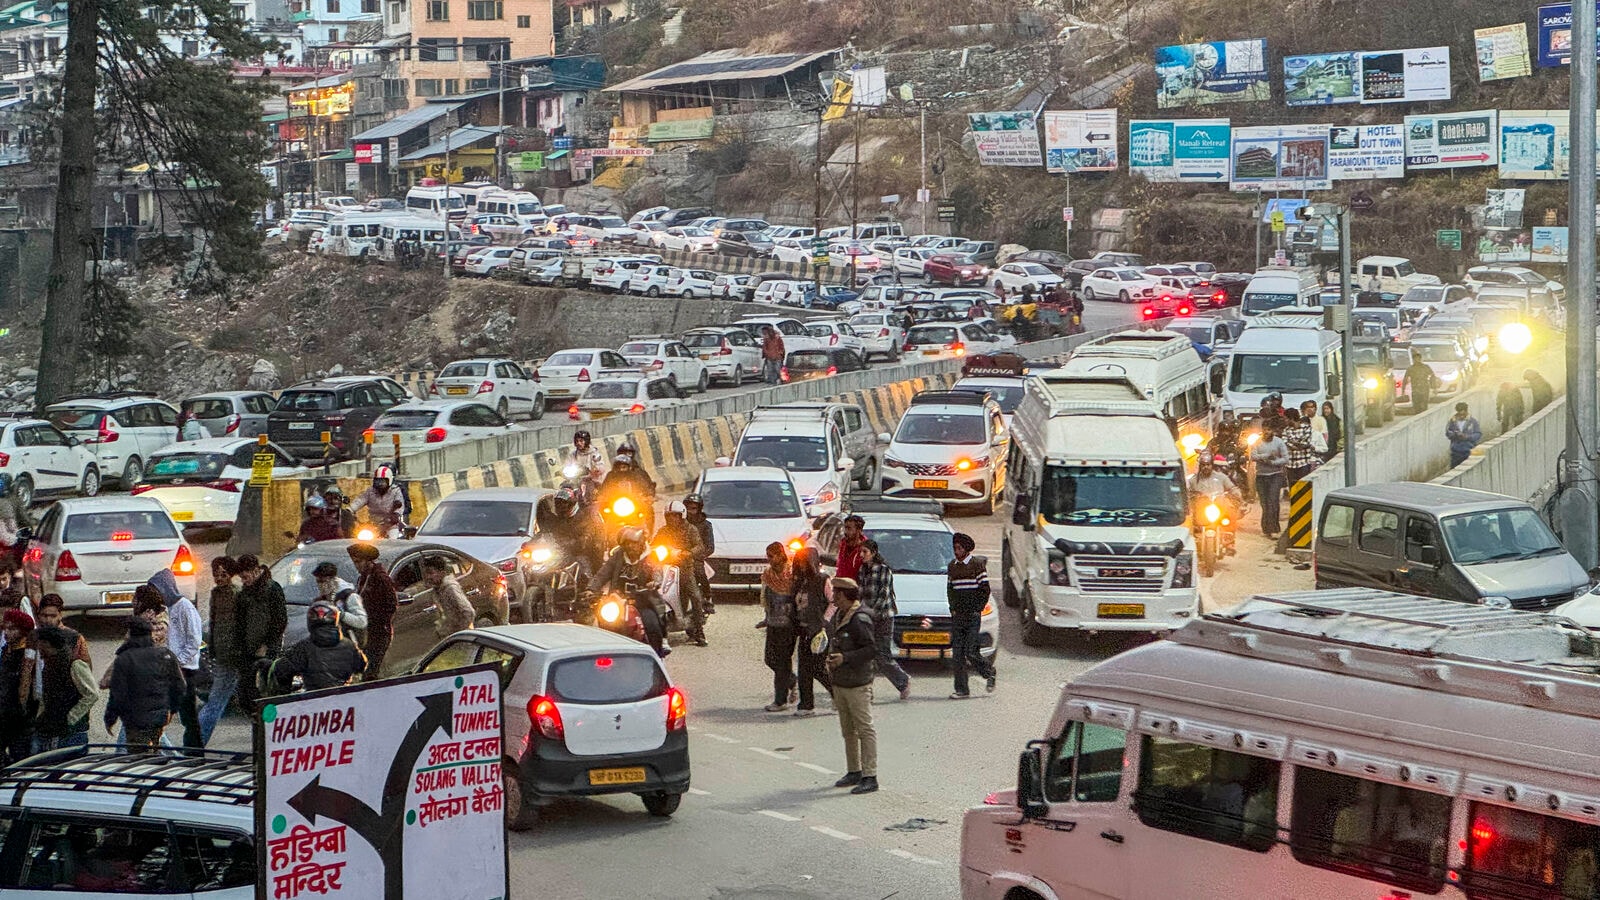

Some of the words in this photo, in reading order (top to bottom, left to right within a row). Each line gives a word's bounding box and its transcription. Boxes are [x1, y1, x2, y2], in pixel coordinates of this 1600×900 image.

[1000, 134, 1017, 144] Valley
[1360, 139, 1377, 148] OUT
[1379, 138, 1402, 147] TOWN
[1367, 126, 1397, 136] HOTEL
[1330, 157, 1370, 166] PARAMOUNT
[1372, 156, 1402, 165] TRAVELS
[458, 684, 496, 706] ATAL
[272, 706, 355, 744] HADIMBA
[454, 710, 500, 734] TUNNEL
[270, 740, 356, 777] TEMPLE
[428, 741, 461, 766] अटल
[463, 736, 500, 760] टनल
[415, 768, 456, 794] SOLANG
[462, 763, 502, 787] VALLEY
[419, 793, 468, 828] सोलंग
[472, 784, 504, 814] वैली
[273, 862, 346, 900] मन्दिर
